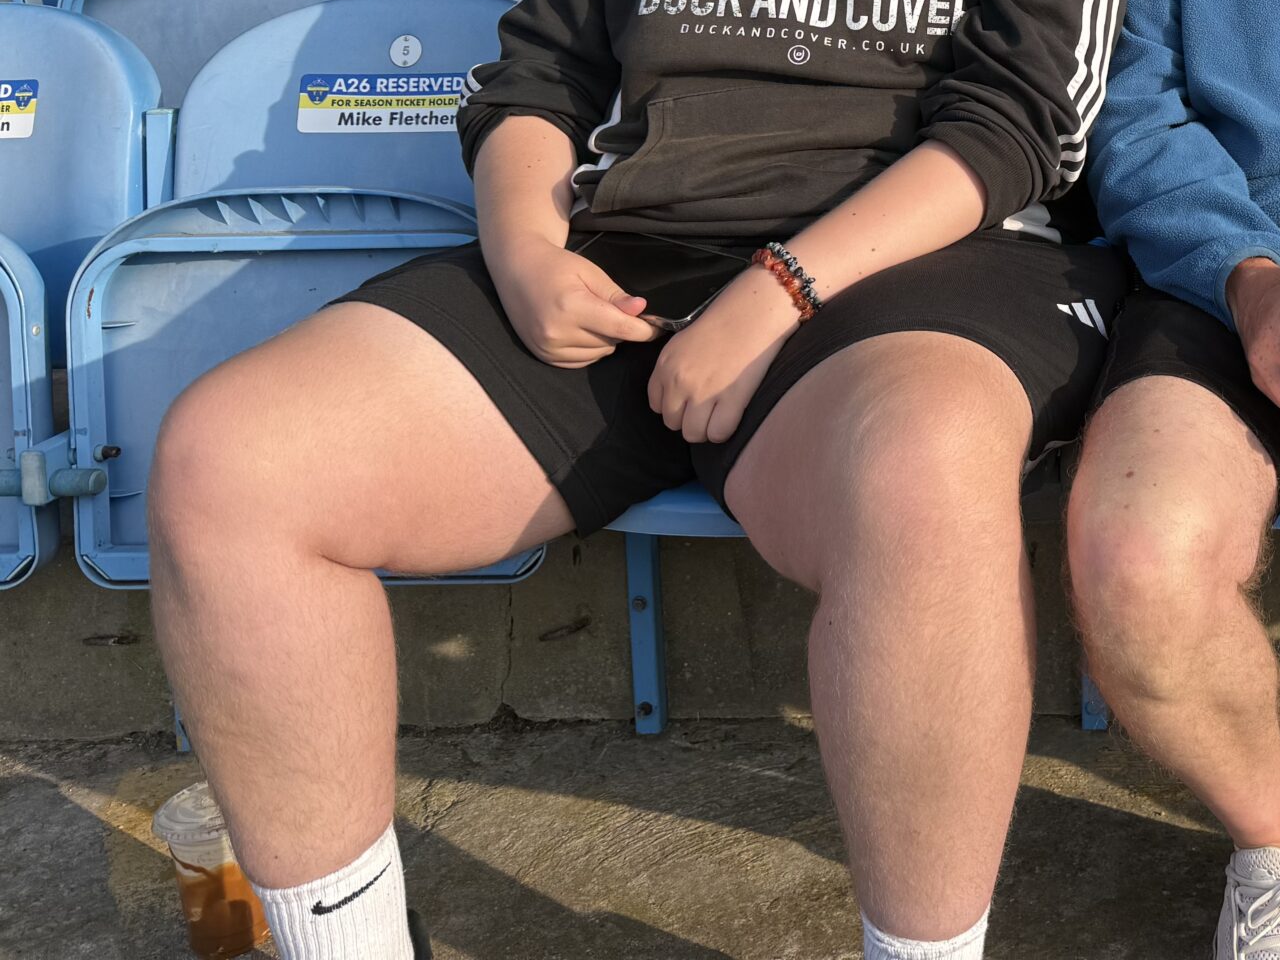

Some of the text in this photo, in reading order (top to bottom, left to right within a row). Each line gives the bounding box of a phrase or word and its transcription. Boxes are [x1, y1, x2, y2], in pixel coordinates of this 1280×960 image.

[680, 23, 926, 56] DUCKANDCOVER.CO.UK
[402, 46, 410, 57] 5
[332, 76, 464, 93] A26 RESERVED
[331, 98, 459, 108] FOR SEASON TICKET HOLDE
[337, 111, 383, 126] Mike
